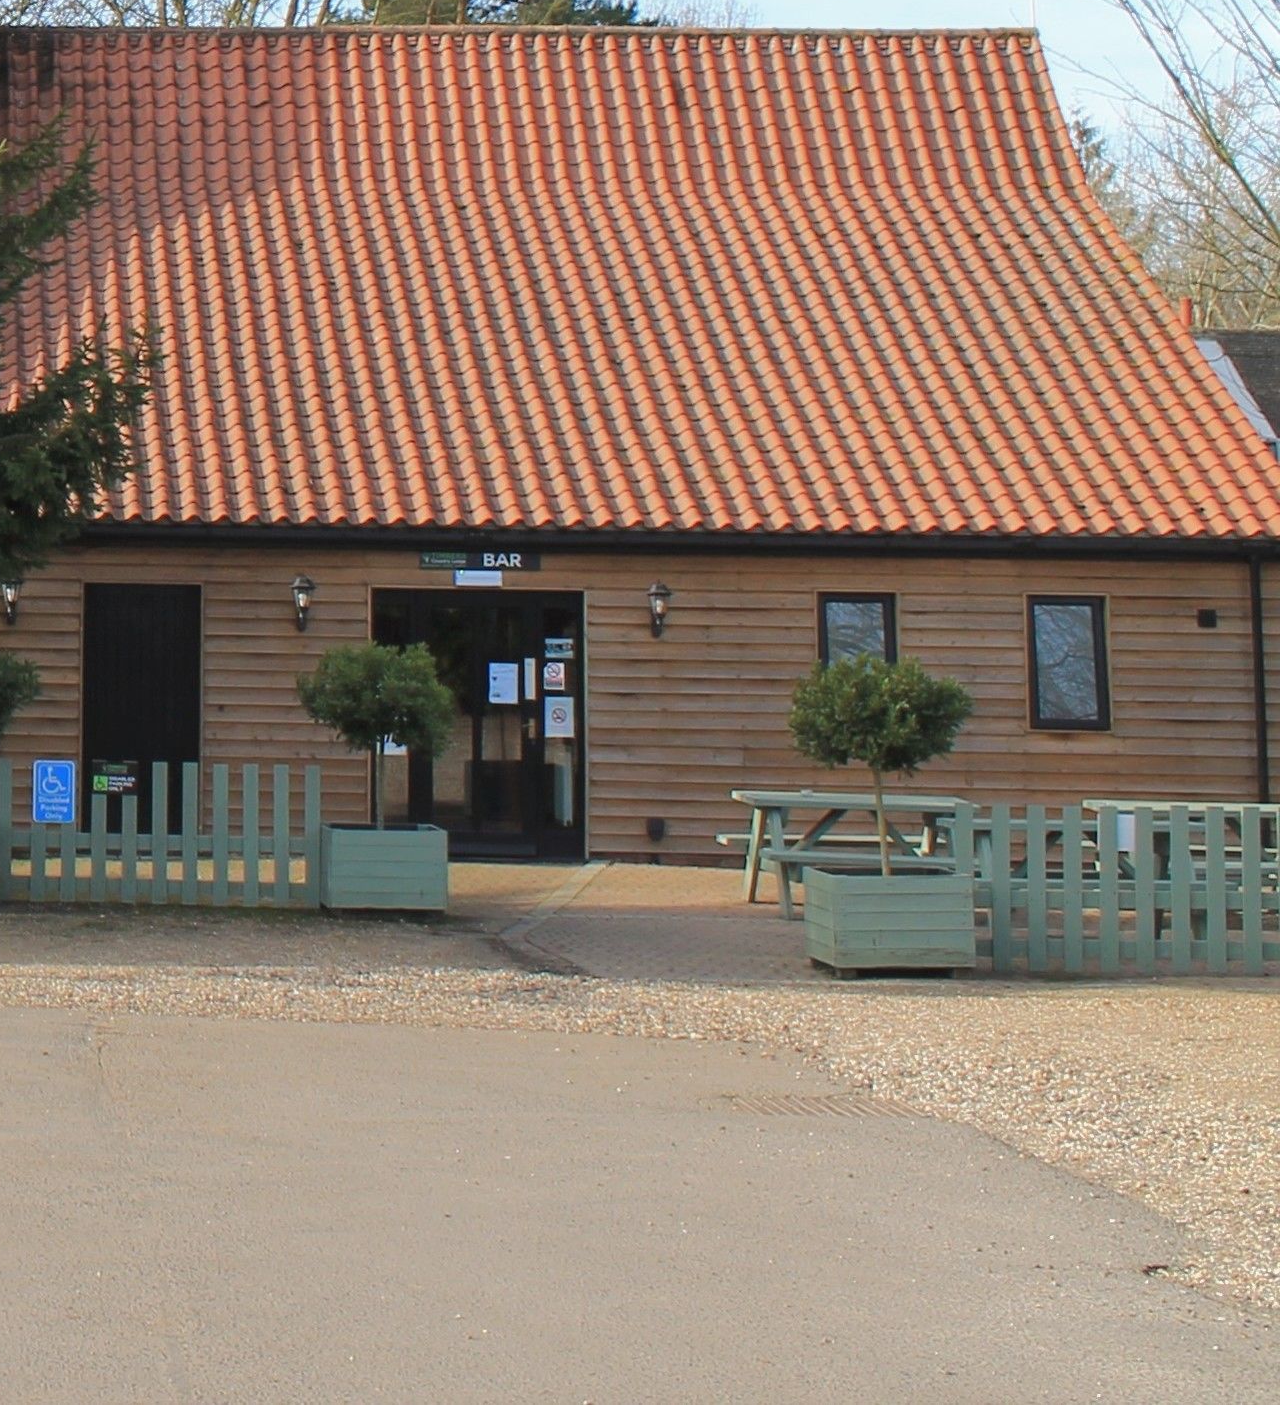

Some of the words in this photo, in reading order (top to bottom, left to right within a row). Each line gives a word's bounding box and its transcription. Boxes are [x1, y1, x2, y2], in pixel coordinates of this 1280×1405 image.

[483, 553, 522, 568] BAR
[41, 803, 68, 812] Parking
[45, 812, 62, 820] Only
